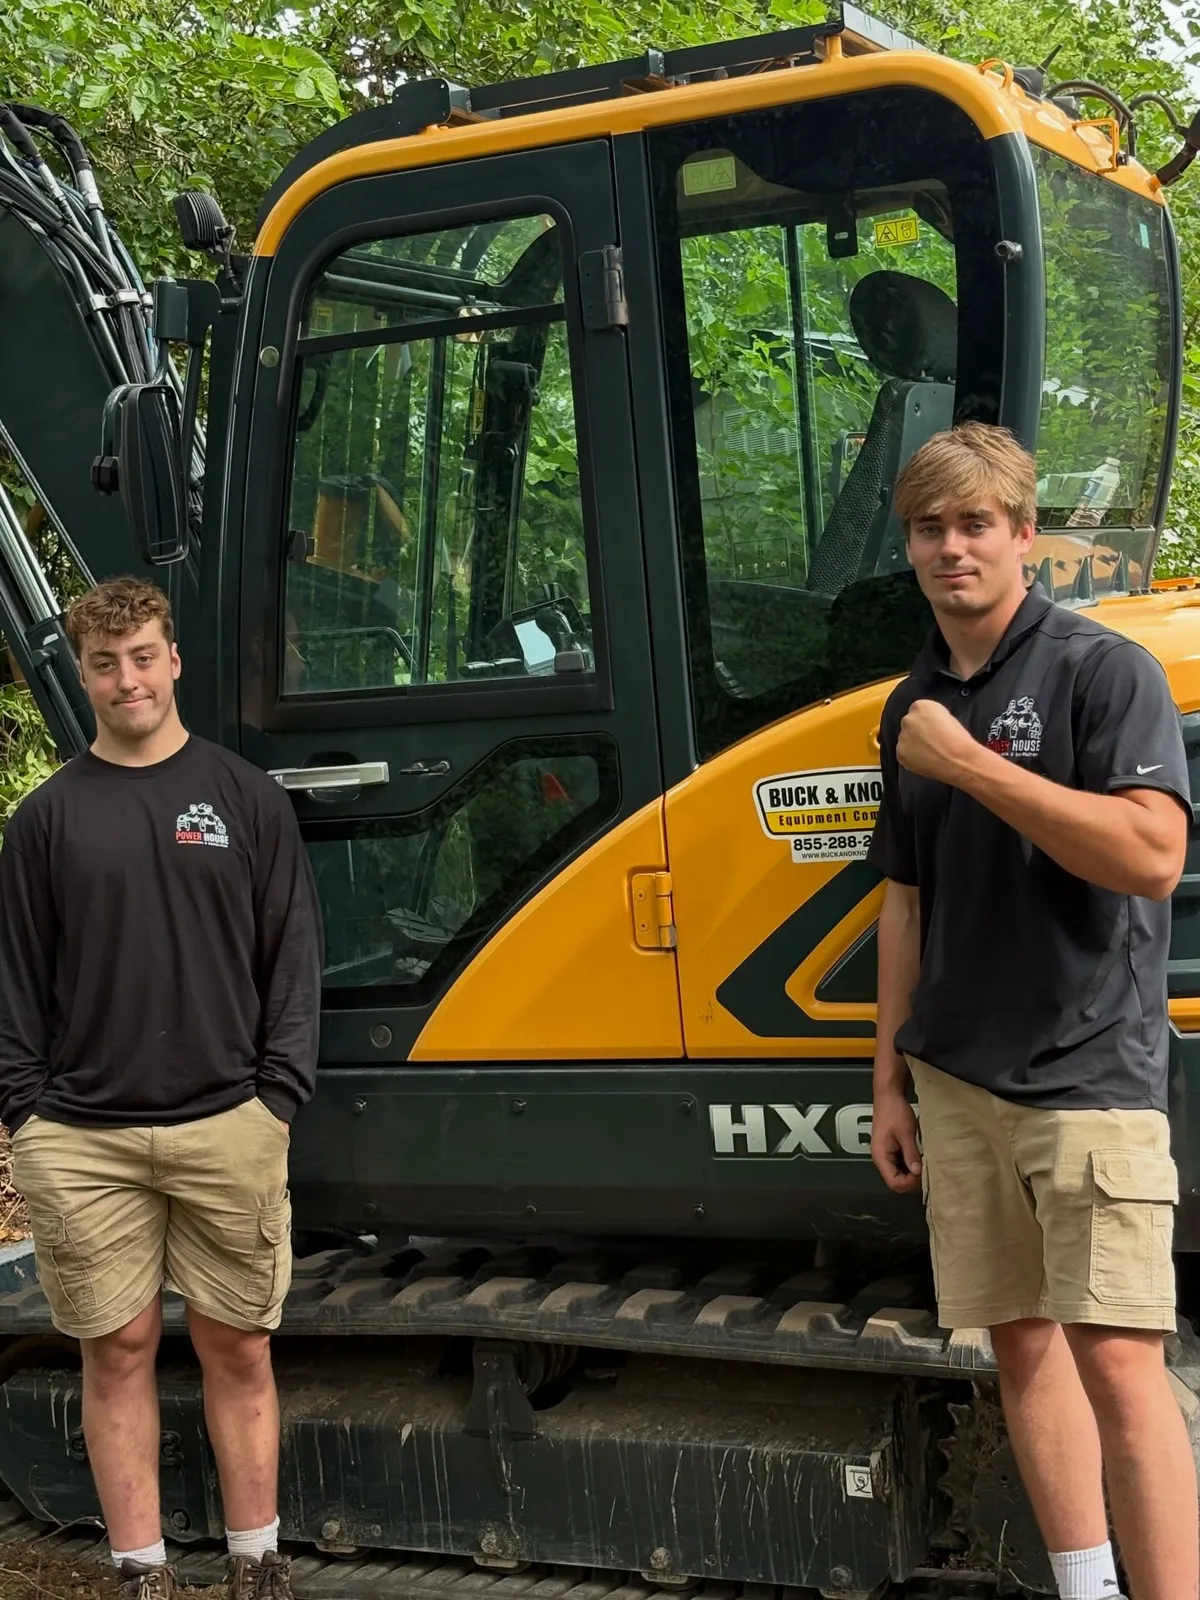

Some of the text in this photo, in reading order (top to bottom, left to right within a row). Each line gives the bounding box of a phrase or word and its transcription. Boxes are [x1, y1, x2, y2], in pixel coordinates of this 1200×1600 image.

[1012, 740, 1041, 751] HOUSE
[769, 786, 819, 808] BUCK
[825, 787, 839, 804] &
[779, 812, 847, 826] Equipment
[176, 831, 202, 841] POWER
[204, 833, 229, 844] HOUSE
[793, 835, 872, 851] 855-288-2
[801, 850, 867, 859] WWW.BUCKANDKNO
[709, 1103, 921, 1154] HX6
